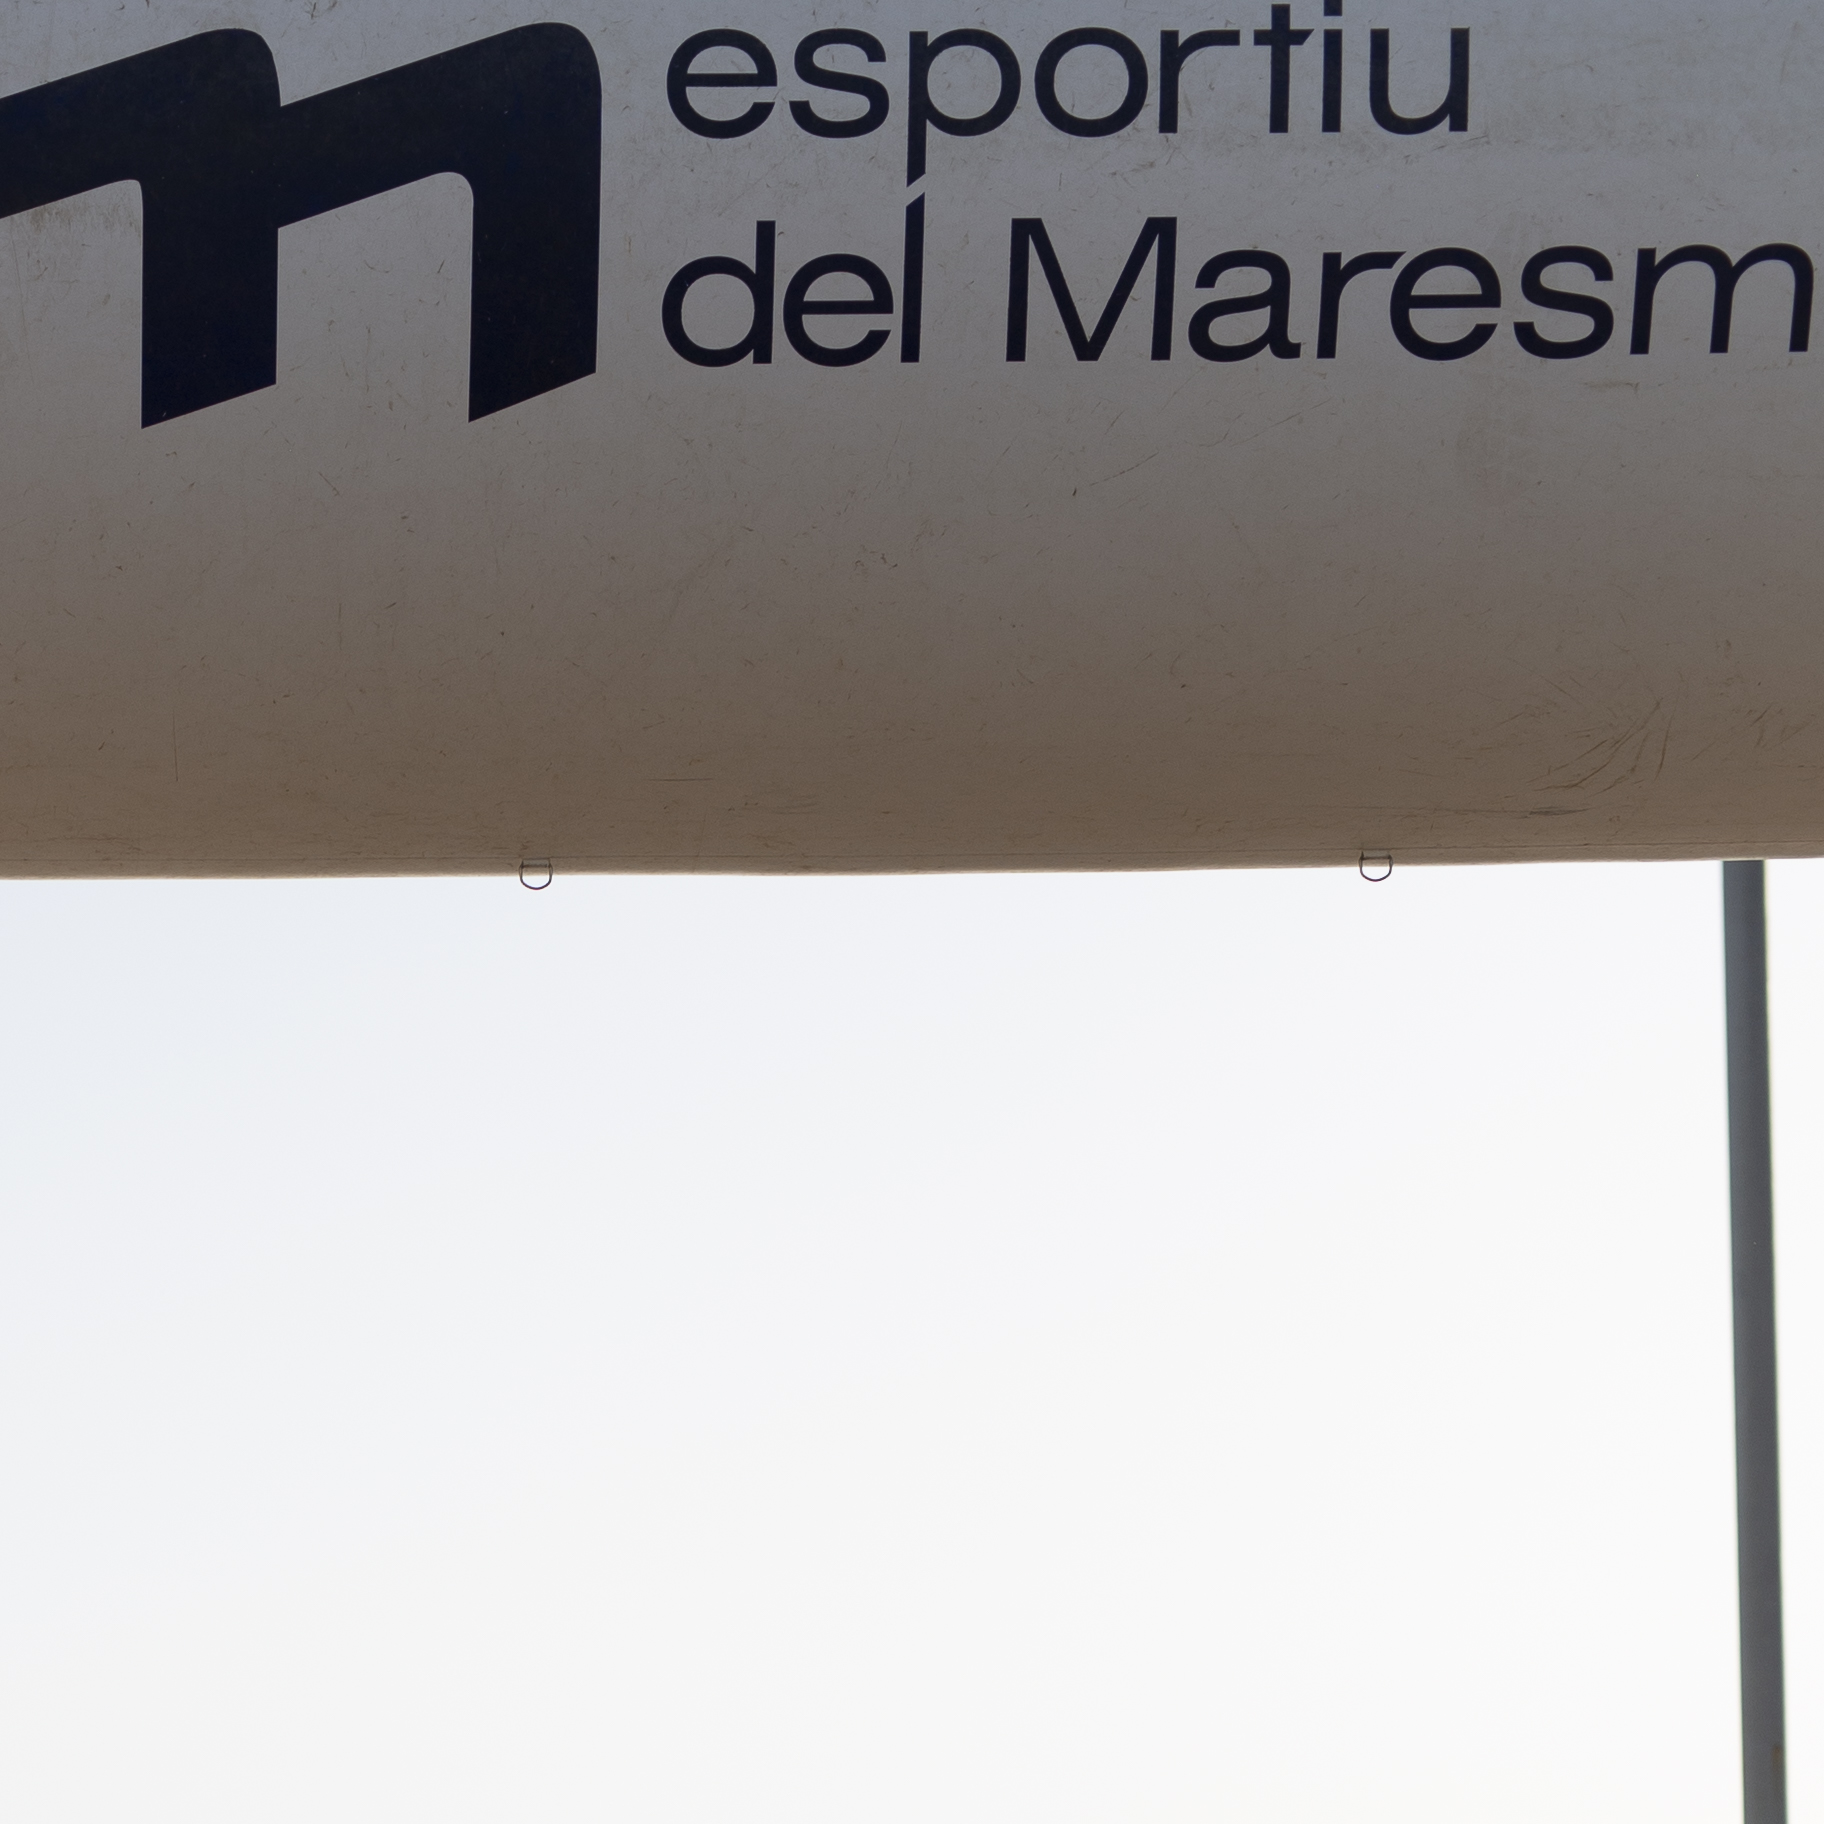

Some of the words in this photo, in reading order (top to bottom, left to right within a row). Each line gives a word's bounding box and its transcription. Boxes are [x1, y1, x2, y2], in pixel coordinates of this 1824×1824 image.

[665, 0, 1470, 188] esportiu
[661, 193, 925, 368] del
[1005, 217, 1815, 363] Maresm
